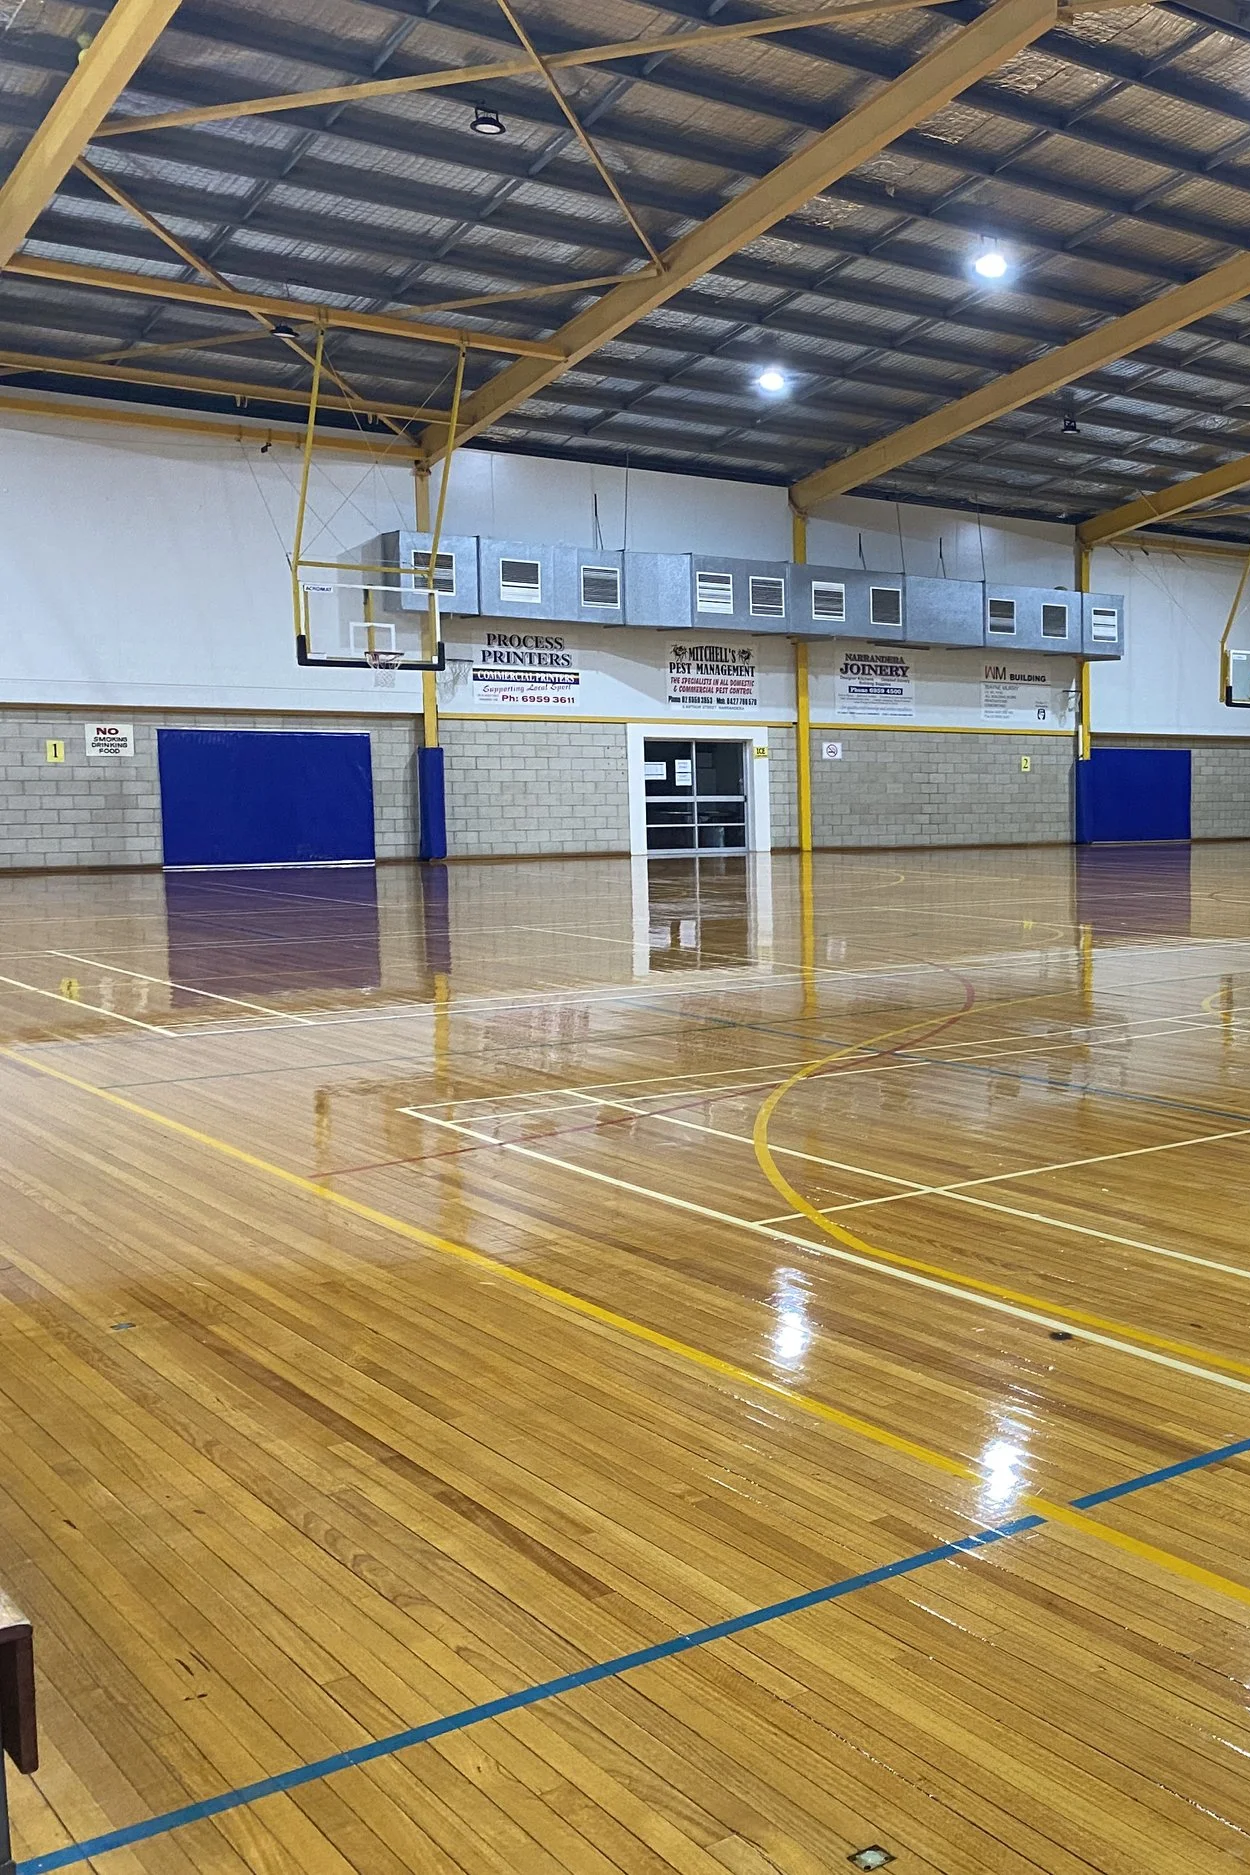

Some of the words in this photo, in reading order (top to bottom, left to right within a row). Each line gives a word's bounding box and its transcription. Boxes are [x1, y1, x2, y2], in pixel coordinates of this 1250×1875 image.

[486, 633, 565, 651] PROCESS
[481, 649, 573, 669] PRINTERS
[688, 645, 737, 664] MITCHELL'S
[669, 661, 692, 675] PEST
[696, 663, 756, 678] MANAGEMENT
[840, 662, 910, 678] JOINERY
[477, 670, 535, 682] COMMERCIAL
[536, 673, 576, 684] PRINTERS
[671, 676, 681, 685] THE
[681, 677, 713, 686] SPECIALISTS
[720, 679, 729, 687] ALL
[1009, 673, 1047, 683] BUILDING
[483, 684, 525, 695] Supporting
[527, 684, 548, 692] Local
[679, 686, 714, 695] COMMERCIAL
[715, 687, 729, 695] PEST
[501, 694, 519, 703] Ph:
[521, 695, 551, 704] 6959
[552, 696, 575, 704] 3611
[96, 727, 120, 736] NO
[52, 743, 59, 759] 1
[1022, 758, 1029, 769] 2
